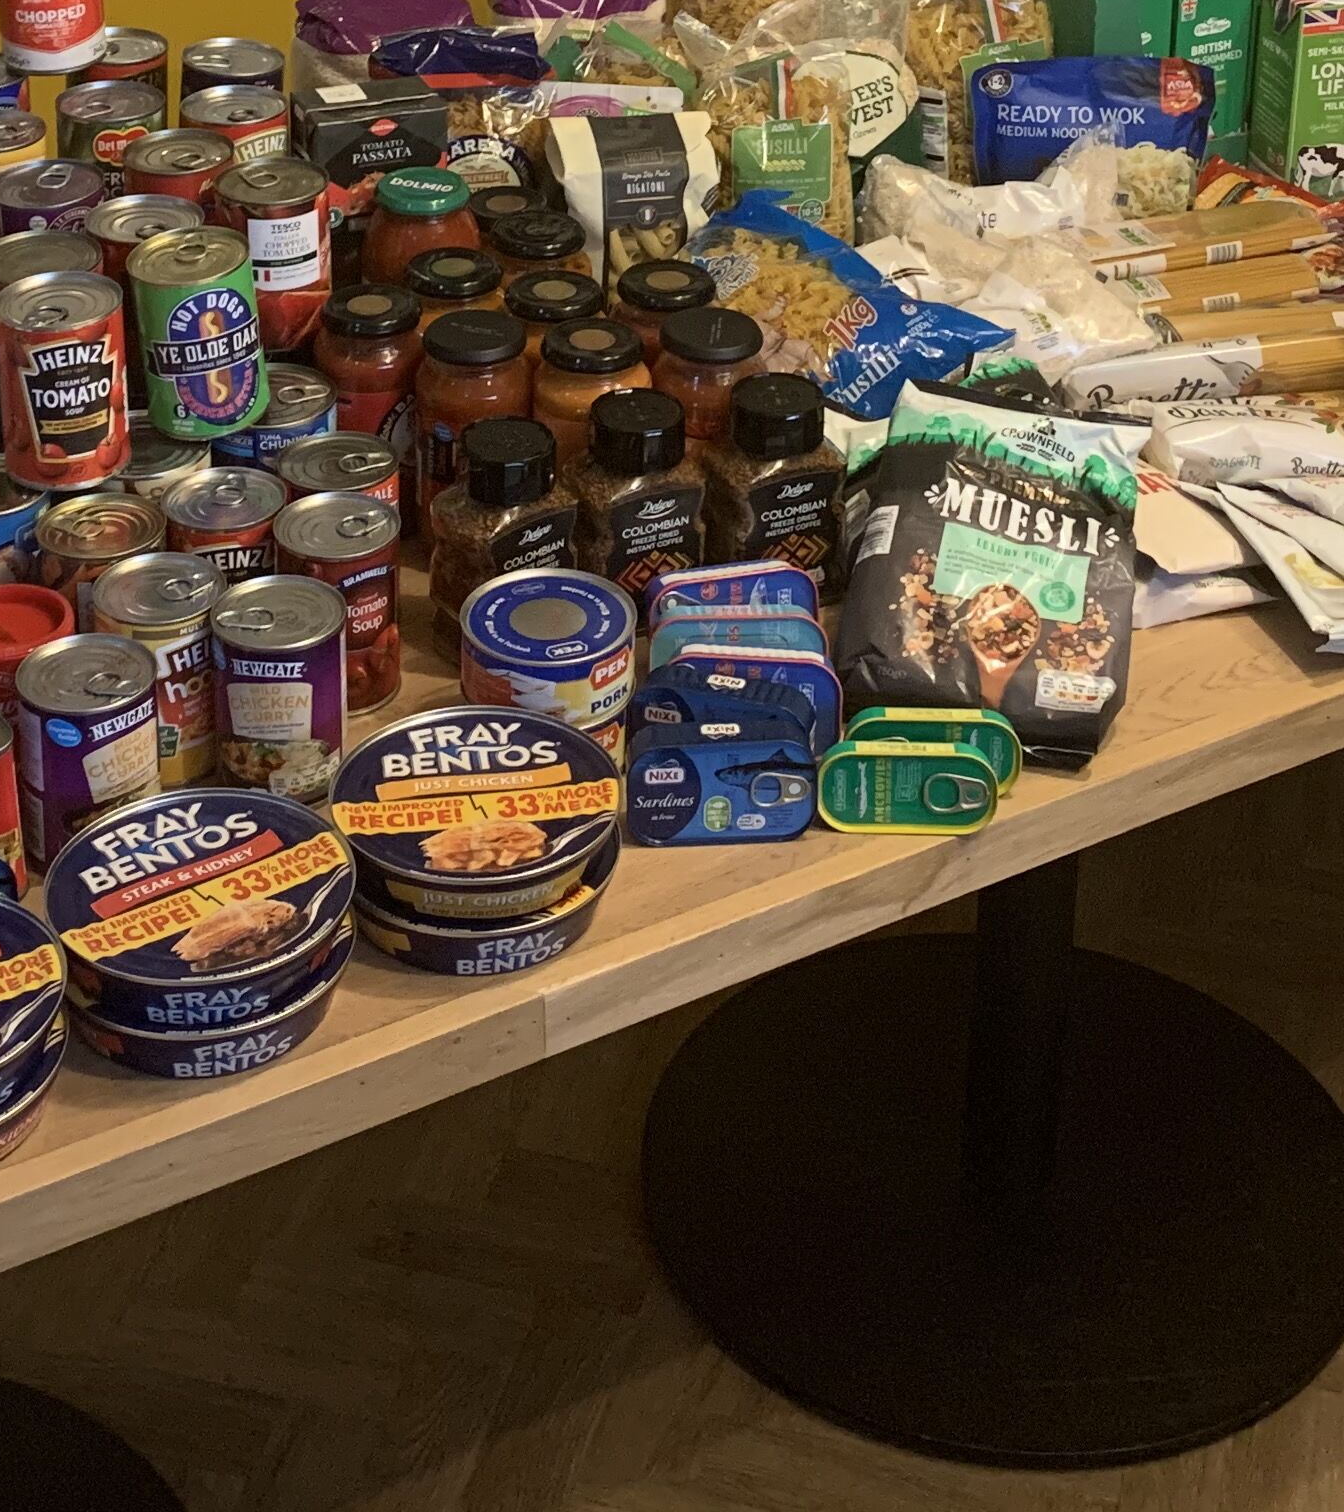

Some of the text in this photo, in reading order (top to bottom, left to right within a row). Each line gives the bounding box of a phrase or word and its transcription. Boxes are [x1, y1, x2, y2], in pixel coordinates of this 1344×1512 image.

[14, 2, 87, 24] CHOPPED
[1190, 39, 1233, 57] BRITISH
[996, 103, 1145, 126] READY TO WOK
[1324, 101, 1344, 111] MILK
[352, 145, 413, 164] PASSATA
[360, 138, 404, 152] TOMATO
[388, 176, 454, 193] DOLMIO
[626, 180, 666, 195] RIGATONI
[171, 291, 245, 333] HOT DOGS
[38, 344, 102, 373] HEINZ
[1000, 426, 1076, 464] CROWNFIELD
[760, 498, 828, 523] COLOMBIAN
[940, 478, 1102, 556] MUESLI
[622, 516, 690, 541] COLOMBIAN
[347, 596, 389, 619] Tomato
[351, 614, 384, 634] Soup
[231, 661, 306, 678] NEWGATE
[229, 693, 310, 712] CHICKEN
[590, 683, 629, 715] PORK
[242, 709, 294, 723] CURRY
[407, 721, 523, 753] FRAY
[381, 739, 561, 779] BENTOS
[414, 773, 535, 793] JUST CHICKEN
[340, 798, 465, 815] NEW IMPROVED
[543, 792, 614, 816] MEAT
[633, 792, 696, 812] Sardines
[348, 808, 464, 831] RECIPE!
[120, 846, 256, 904] STEAK & KIDNEY
[68, 893, 192, 943] NEW IMPROVED
[82, 903, 202, 955] RECIPE!
